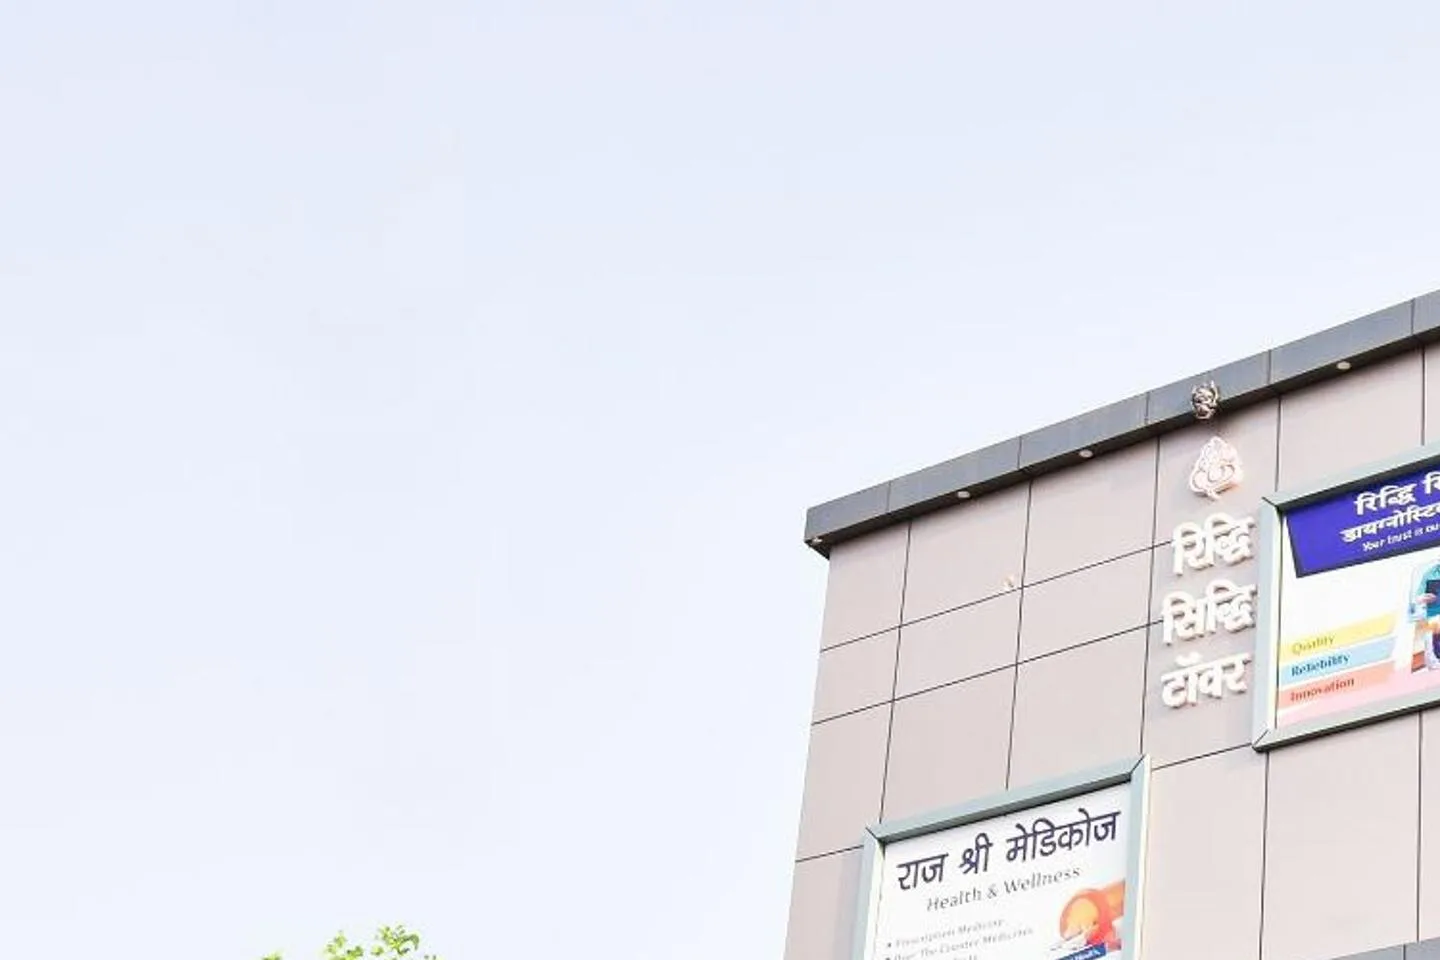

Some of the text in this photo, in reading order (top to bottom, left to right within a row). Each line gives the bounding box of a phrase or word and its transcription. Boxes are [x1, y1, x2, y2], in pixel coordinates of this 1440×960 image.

[1355, 485, 1417, 515] रिद्धि
[1160, 651, 1252, 709] टॉवर
[1290, 678, 1355, 702] Innovation
[897, 807, 1122, 891] राज श्री मेडिकोज
[926, 867, 1081, 912] Health & Wellness
